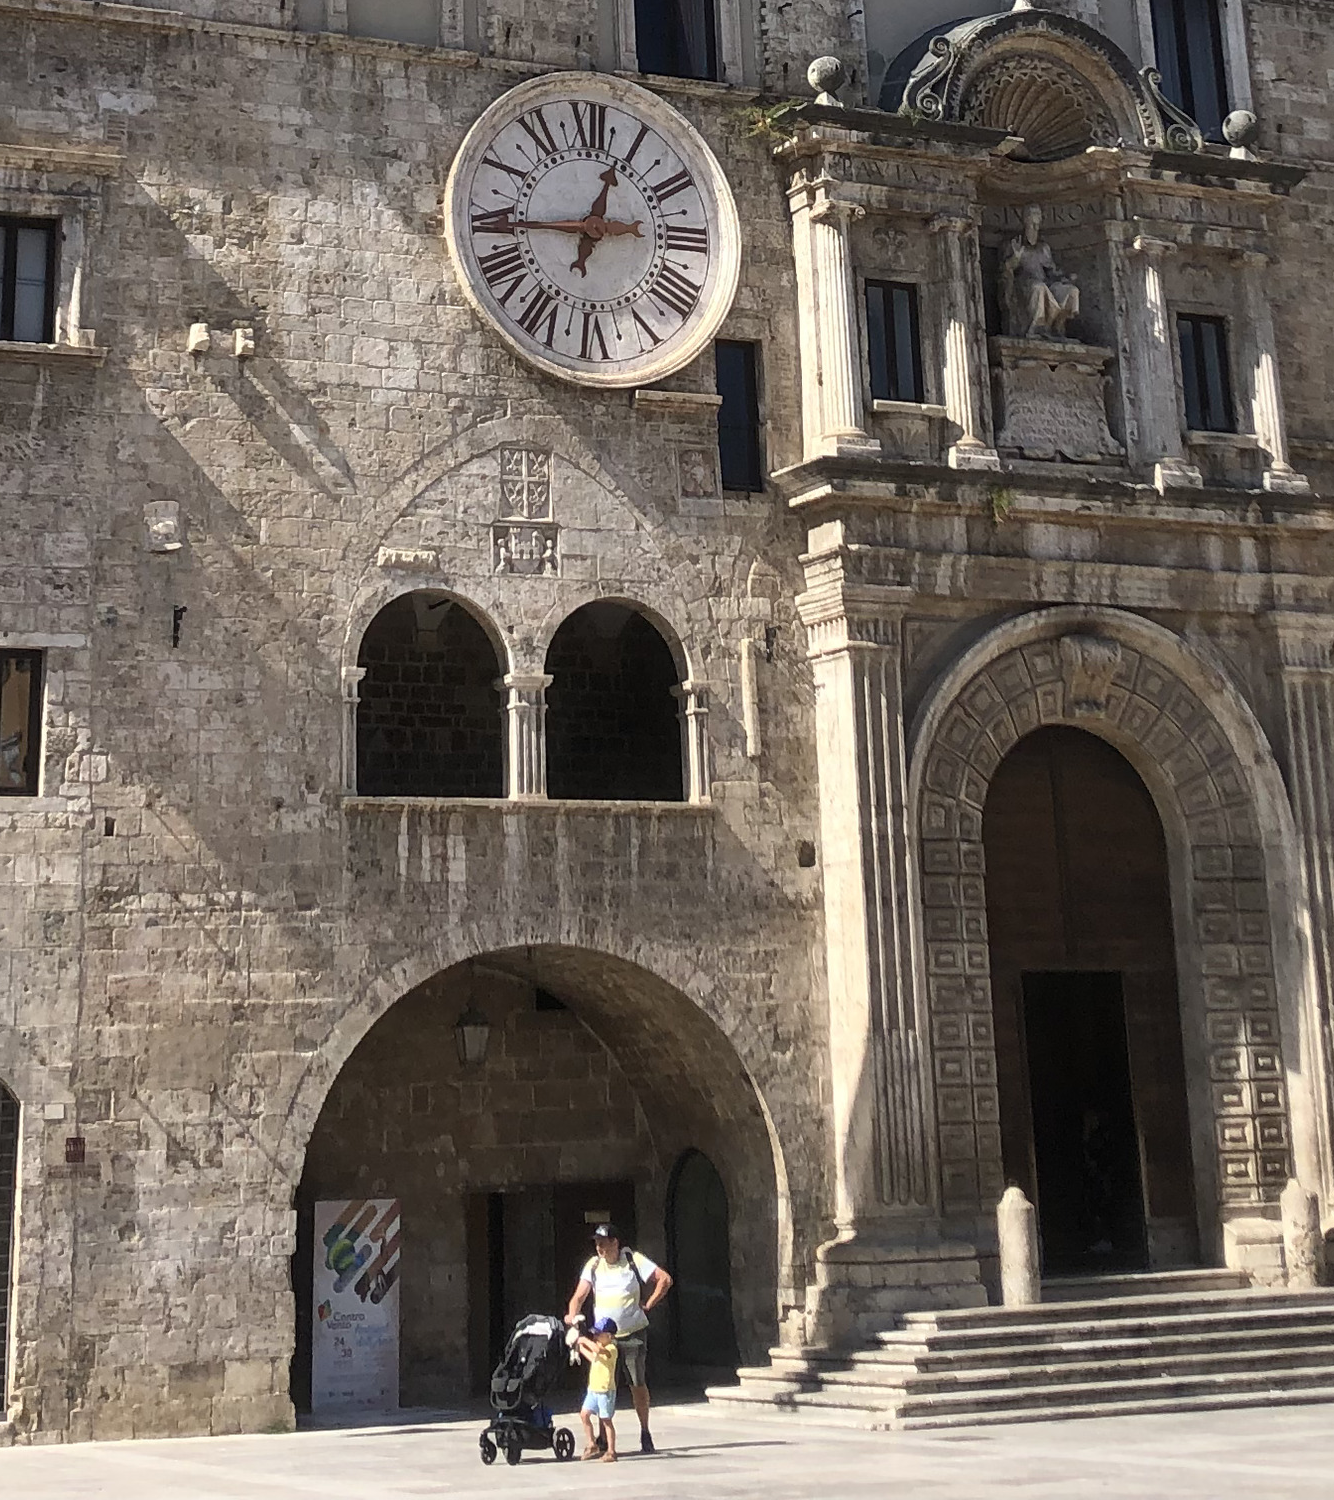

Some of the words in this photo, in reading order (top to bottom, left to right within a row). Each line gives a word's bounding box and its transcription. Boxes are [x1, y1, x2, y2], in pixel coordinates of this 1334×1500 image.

[516, 108, 559, 163] XI
[569, 101, 607, 151] XII
[623, 123, 650, 164] I
[481, 144, 529, 191] X
[651, 169, 695, 204] II
[665, 223, 708, 254] III
[477, 245, 530, 308] VIII
[649, 264, 702, 321] IIII
[514, 285, 559, 348] VII
[577, 311, 613, 360] VI
[631, 306, 665, 353] V
